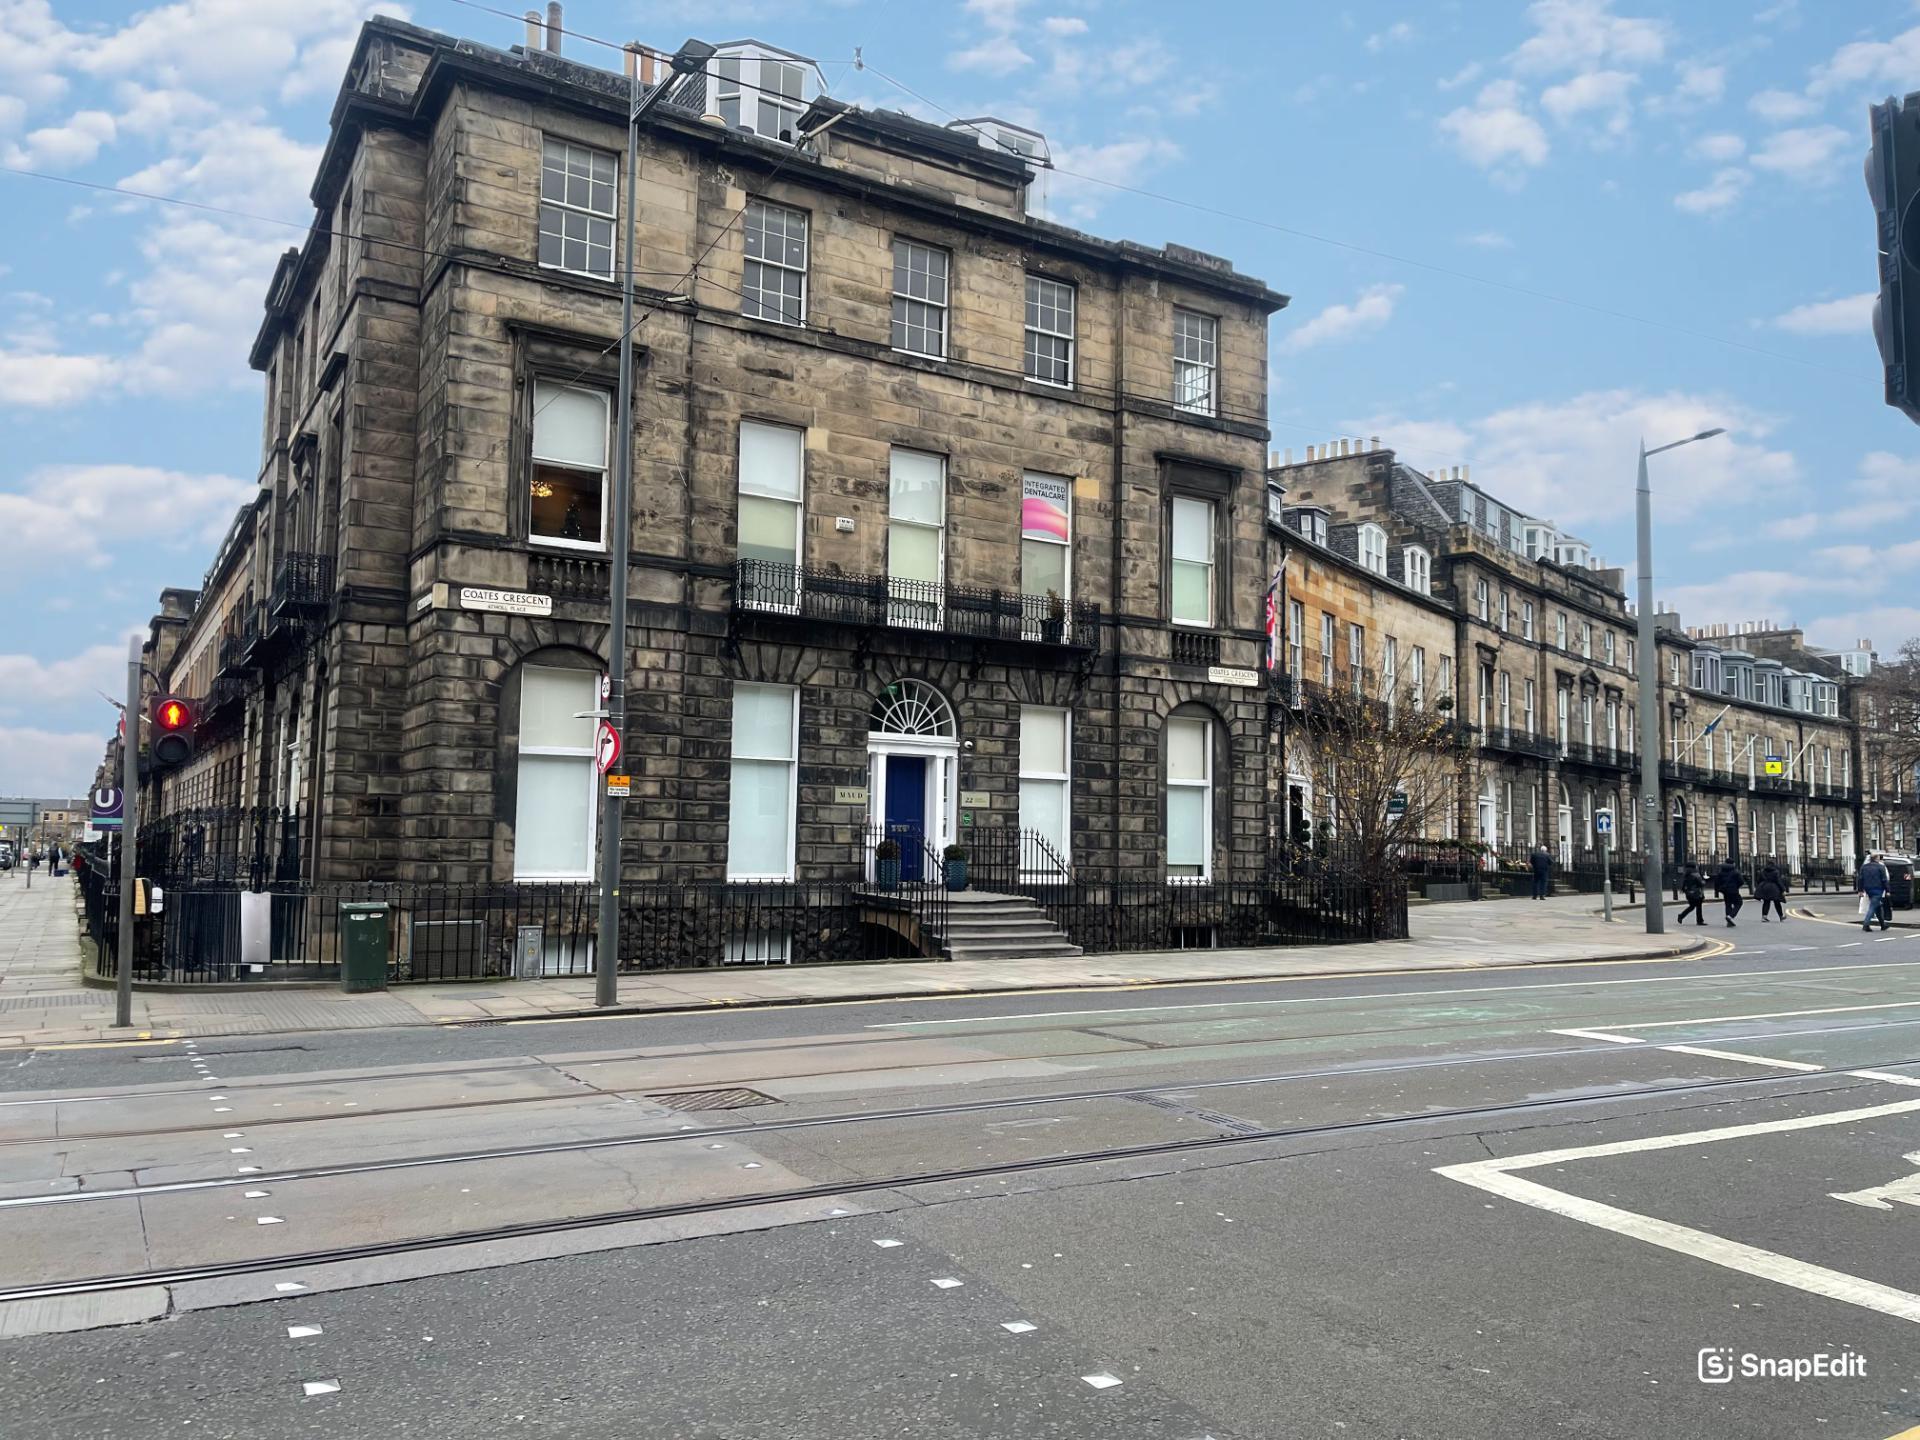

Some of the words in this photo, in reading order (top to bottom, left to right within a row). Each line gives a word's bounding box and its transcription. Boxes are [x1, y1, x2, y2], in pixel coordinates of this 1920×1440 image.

[1024, 479, 1066, 494] INTEGRATED
[1024, 487, 1066, 501] DENTALCARE
[463, 589, 499, 601] COATES
[502, 593, 550, 606] CRESCENT
[1209, 667, 1230, 676] COATES
[1231, 670, 1257, 679] CRESCENT
